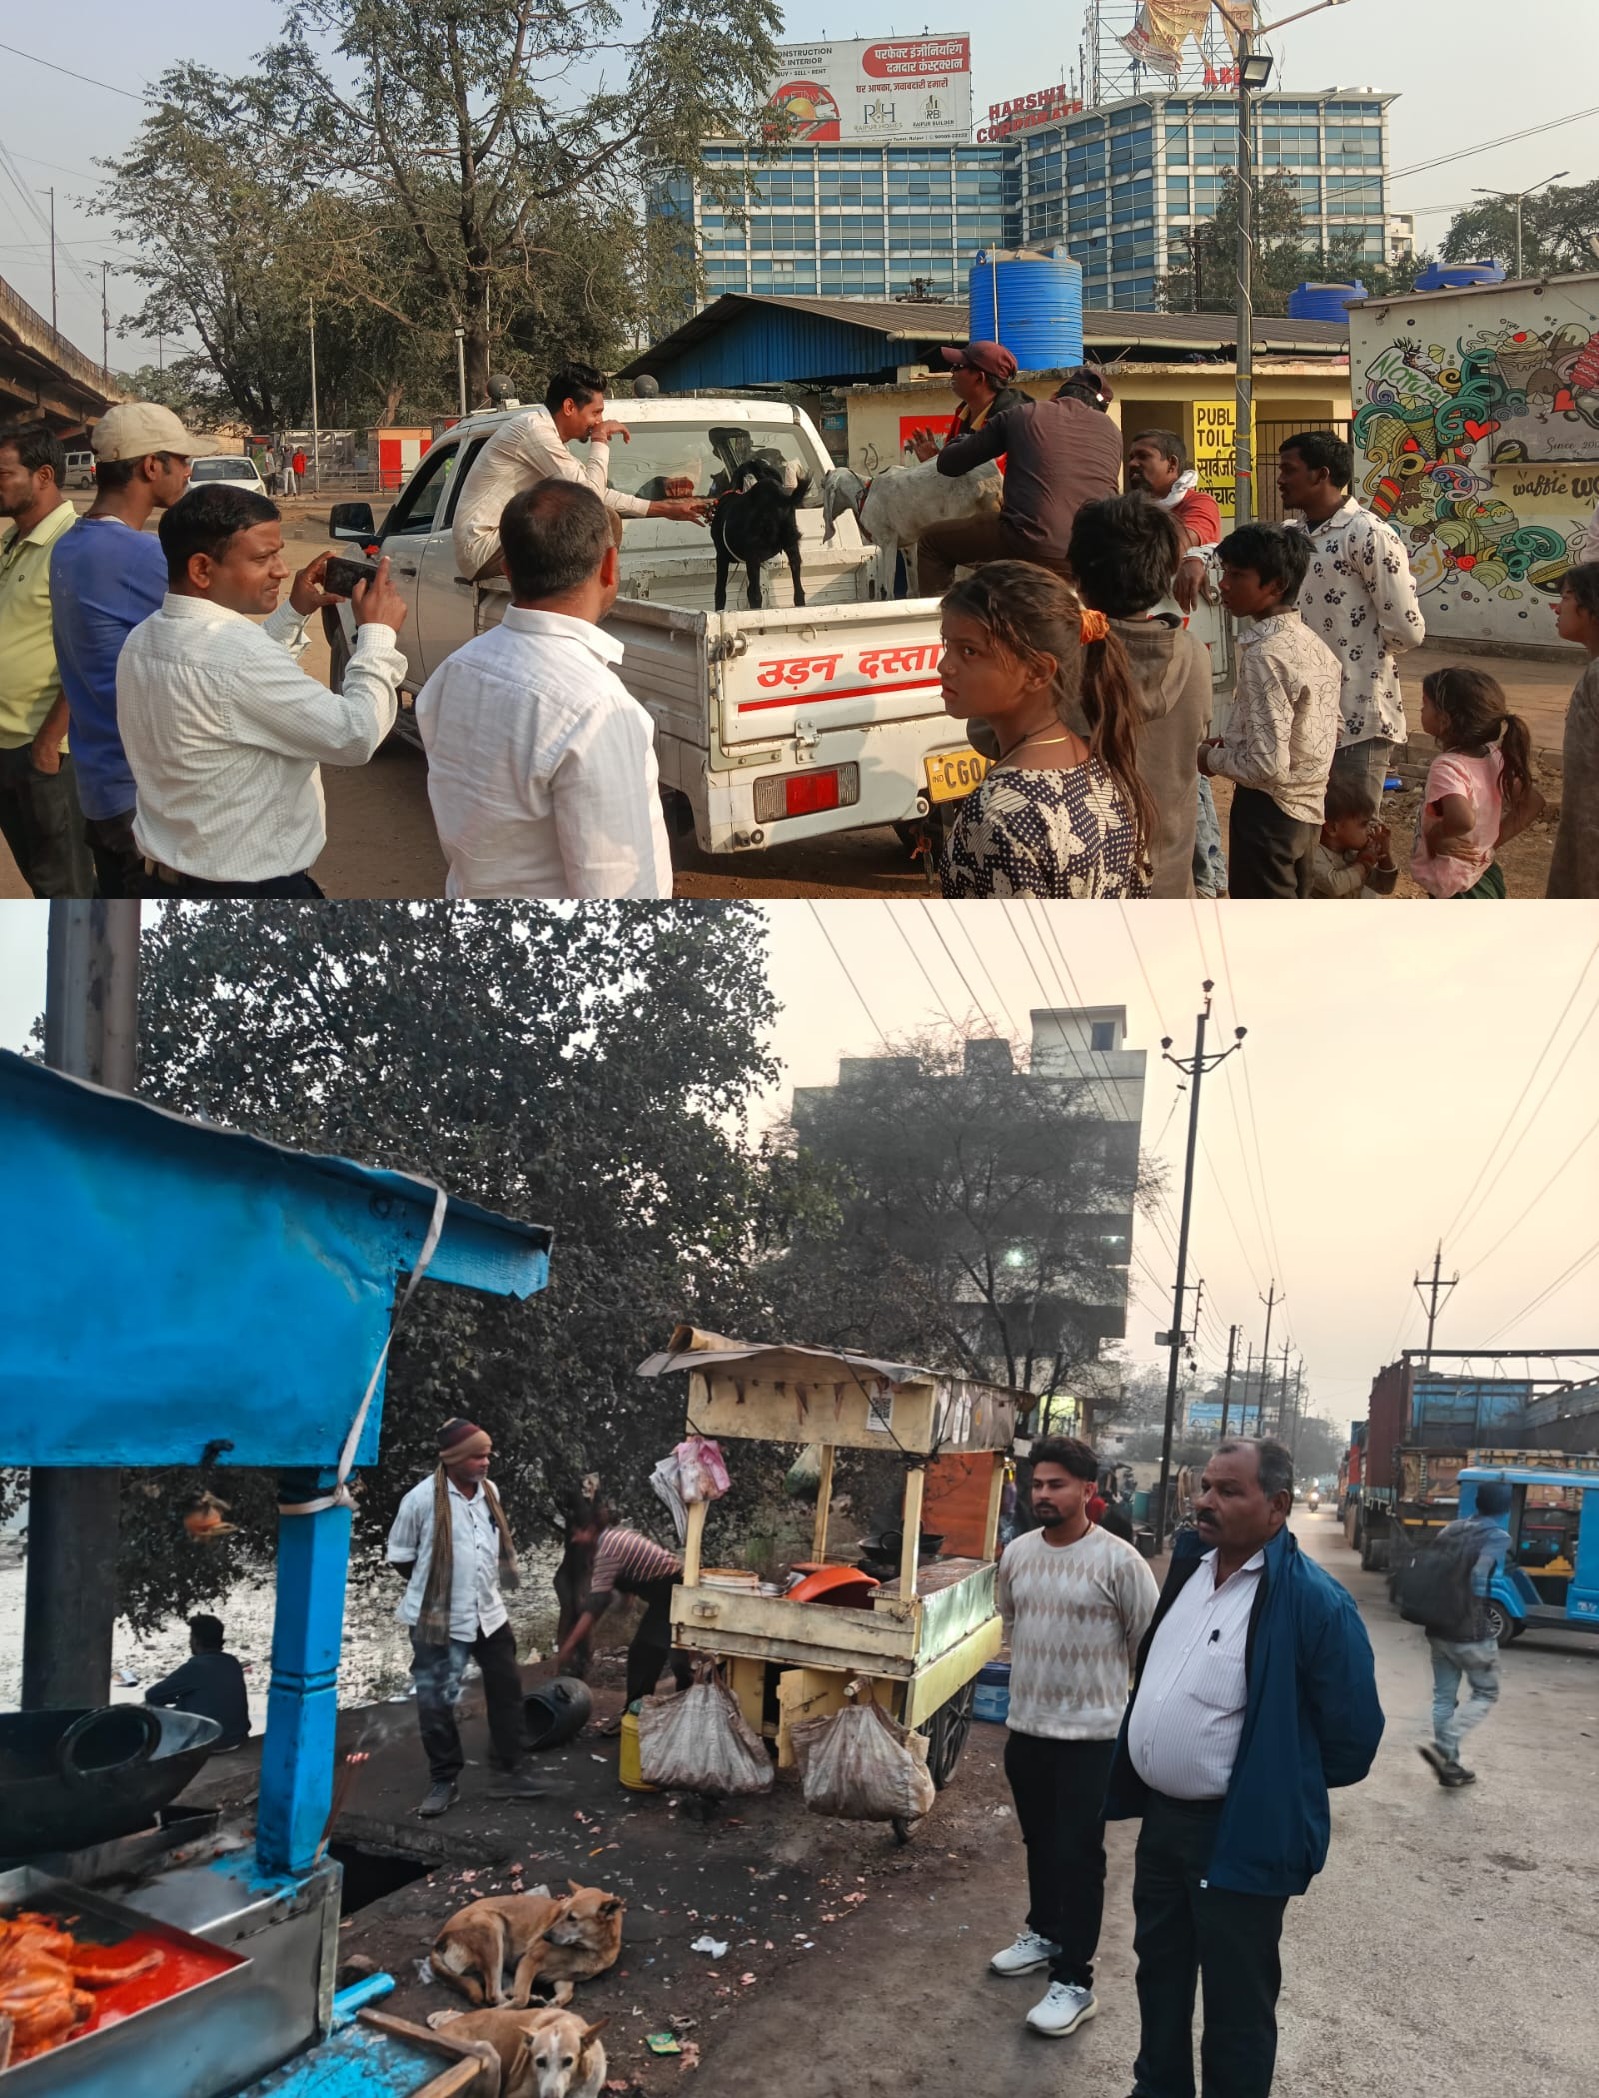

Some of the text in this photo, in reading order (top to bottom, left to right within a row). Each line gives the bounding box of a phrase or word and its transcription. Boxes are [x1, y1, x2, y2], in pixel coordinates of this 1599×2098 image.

[778, 47, 833, 59] ONSTRUCTION
[787, 57, 823, 67] INTERIOR
[874, 46, 908, 60] परफेक्ट
[886, 61, 917, 74] दमदार
[855, 83, 867, 94] घर
[989, 84, 1067, 121] HARSHIT
[1197, 407, 1236, 426] PUBL
[1196, 428, 1236, 448] TOIL
[1544, 436, 1576, 454] Since
[1512, 474, 1569, 498] waffle
[756, 643, 945, 691] उड़न दस्ता
[944, 757, 982, 789] CG0
